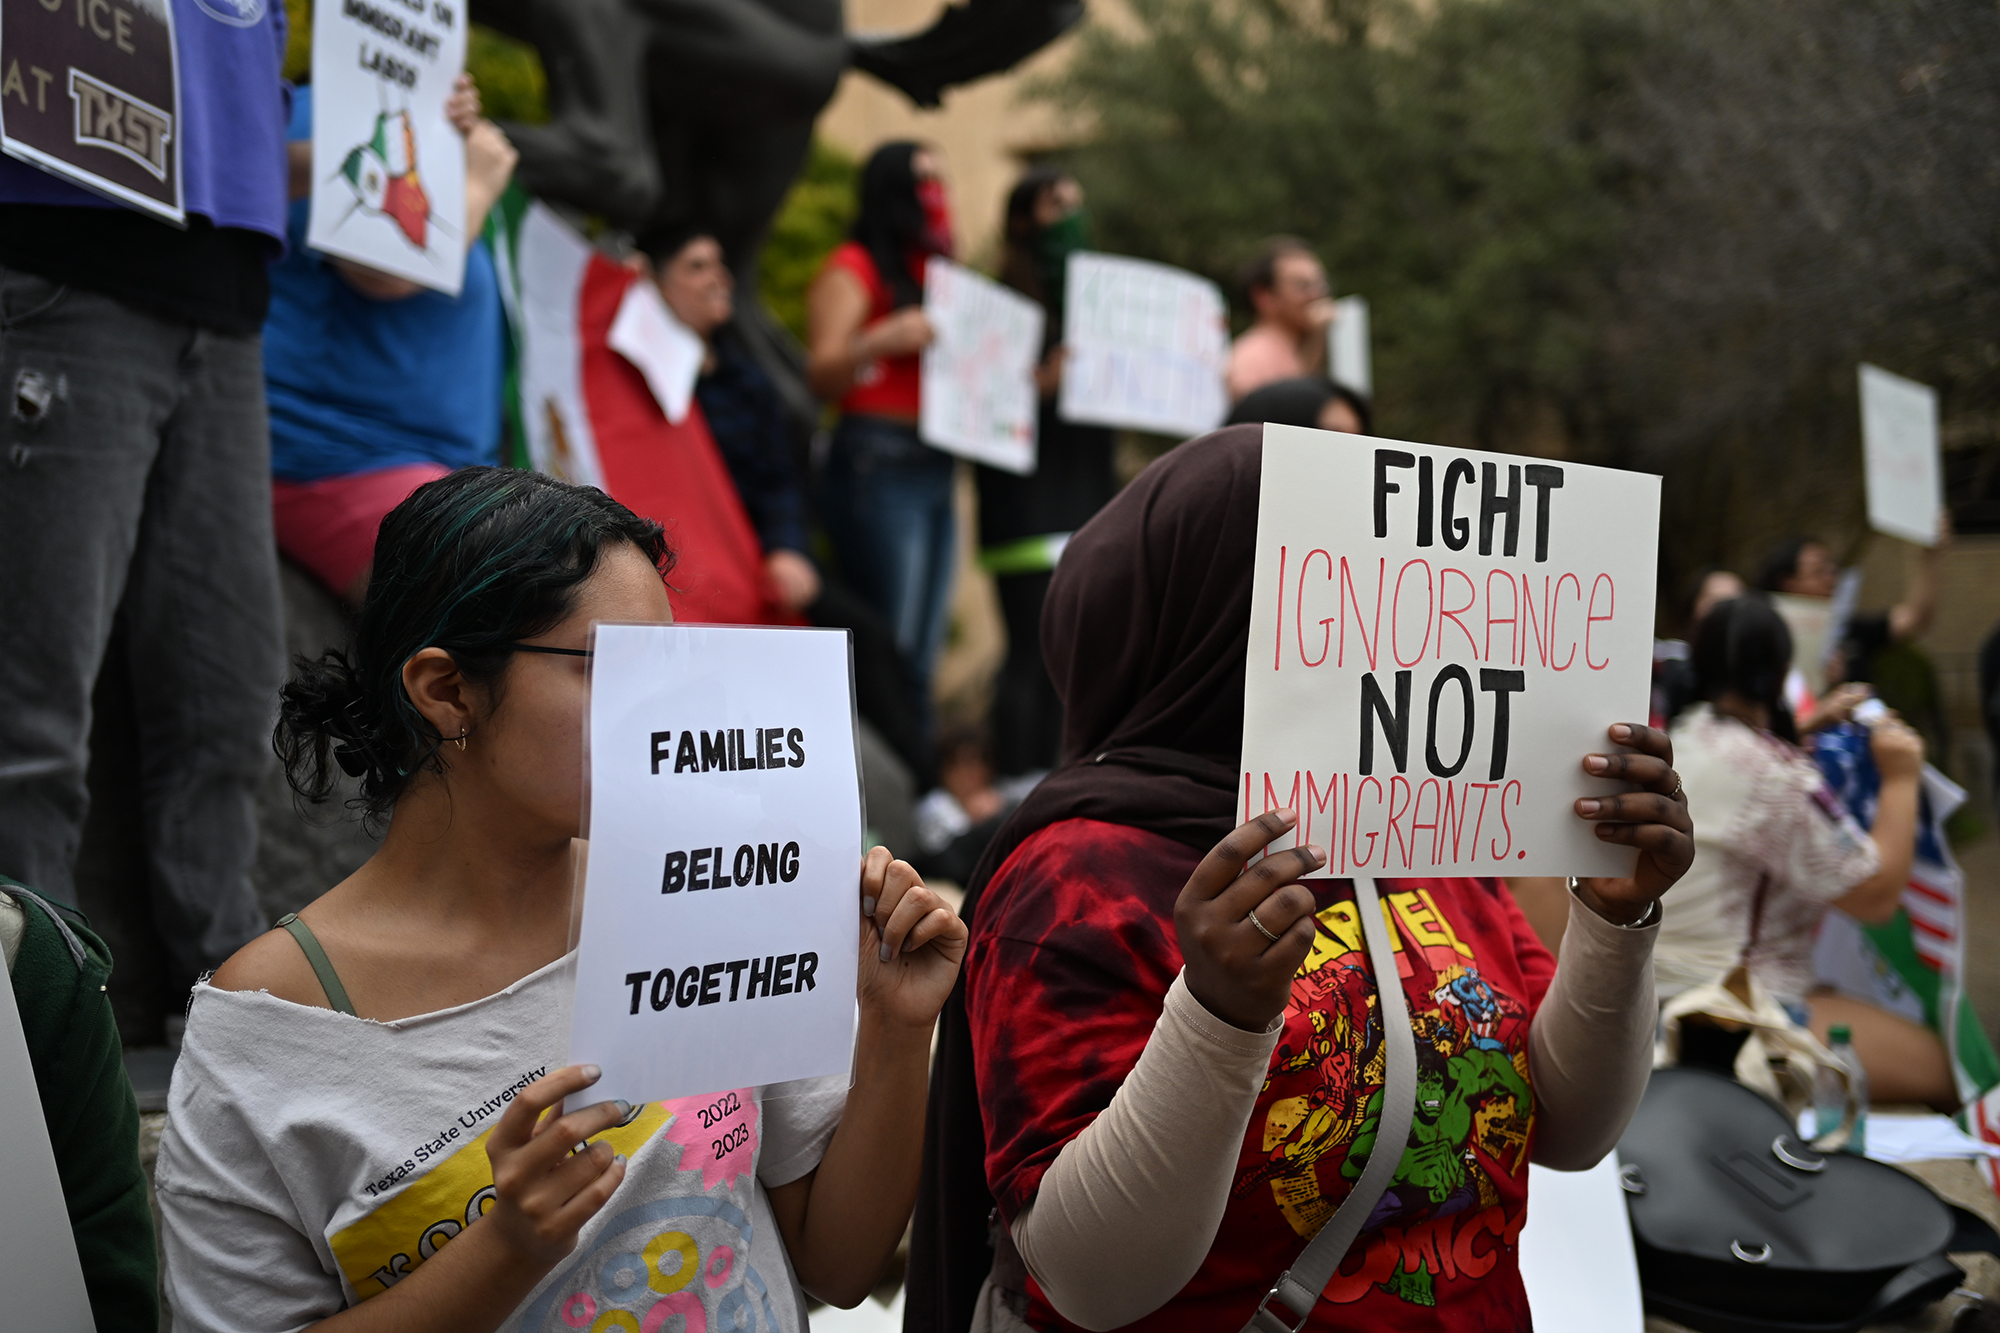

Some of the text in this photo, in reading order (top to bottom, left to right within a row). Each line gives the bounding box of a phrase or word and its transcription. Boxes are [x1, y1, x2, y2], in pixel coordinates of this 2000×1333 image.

[76, 0, 136, 56] ICE
[2, 58, 168, 174] AT TXST
[1374, 449, 1563, 563] FIGHT
[650, 727, 805, 775] FAMILIES
[1358, 664, 1525, 781] NOT
[661, 840, 800, 895] BELONG
[625, 951, 819, 1015] TOGETHER
[365, 1155, 415, 1198] Texas
[415, 1127, 461, 1162] State
[458, 1066, 547, 1130] University
[697, 1092, 741, 1129] 2022
[712, 1122, 749, 1160] 2023
